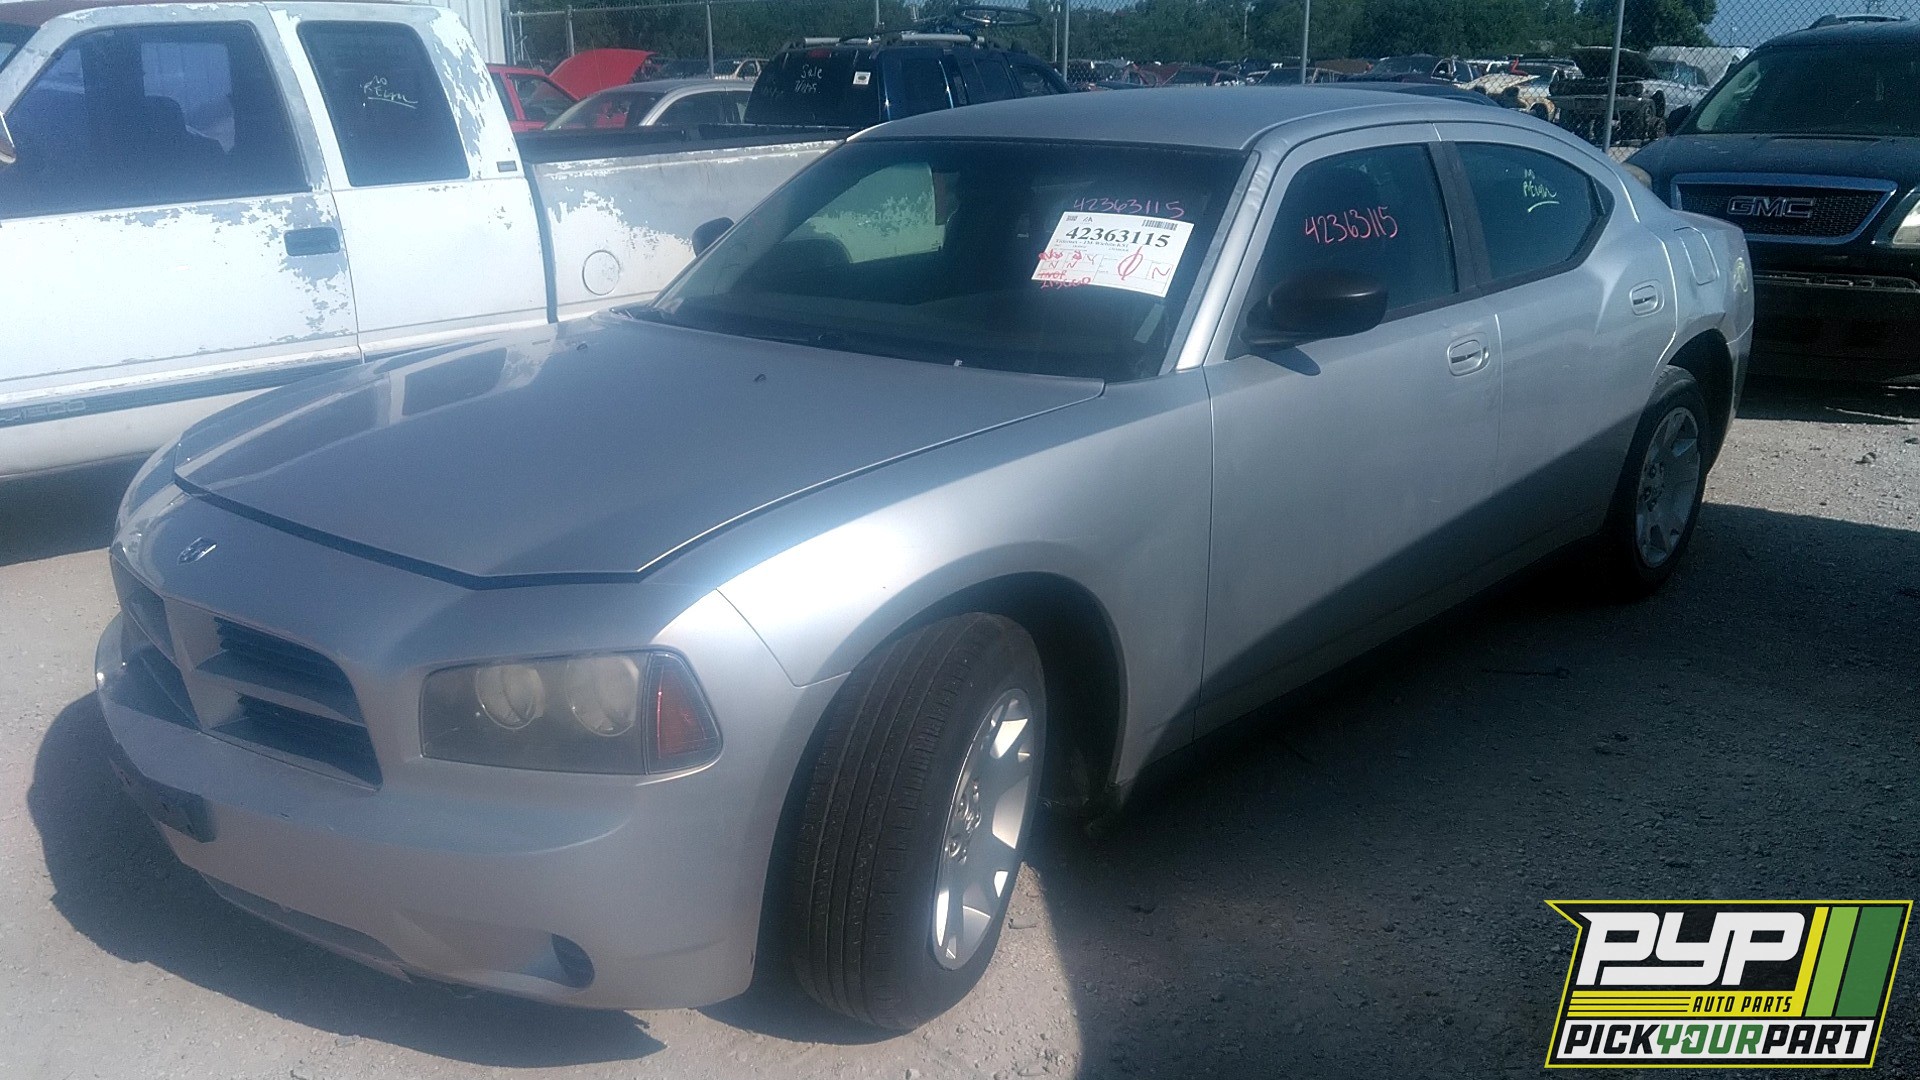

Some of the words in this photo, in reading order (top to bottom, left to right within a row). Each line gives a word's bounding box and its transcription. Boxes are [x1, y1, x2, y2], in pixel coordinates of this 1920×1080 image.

[1073, 196, 1185, 219] 42363115
[1727, 195, 1813, 218] GMC
[1305, 206, 1398, 243] 42363115
[1065, 226, 1171, 248] 42363115
